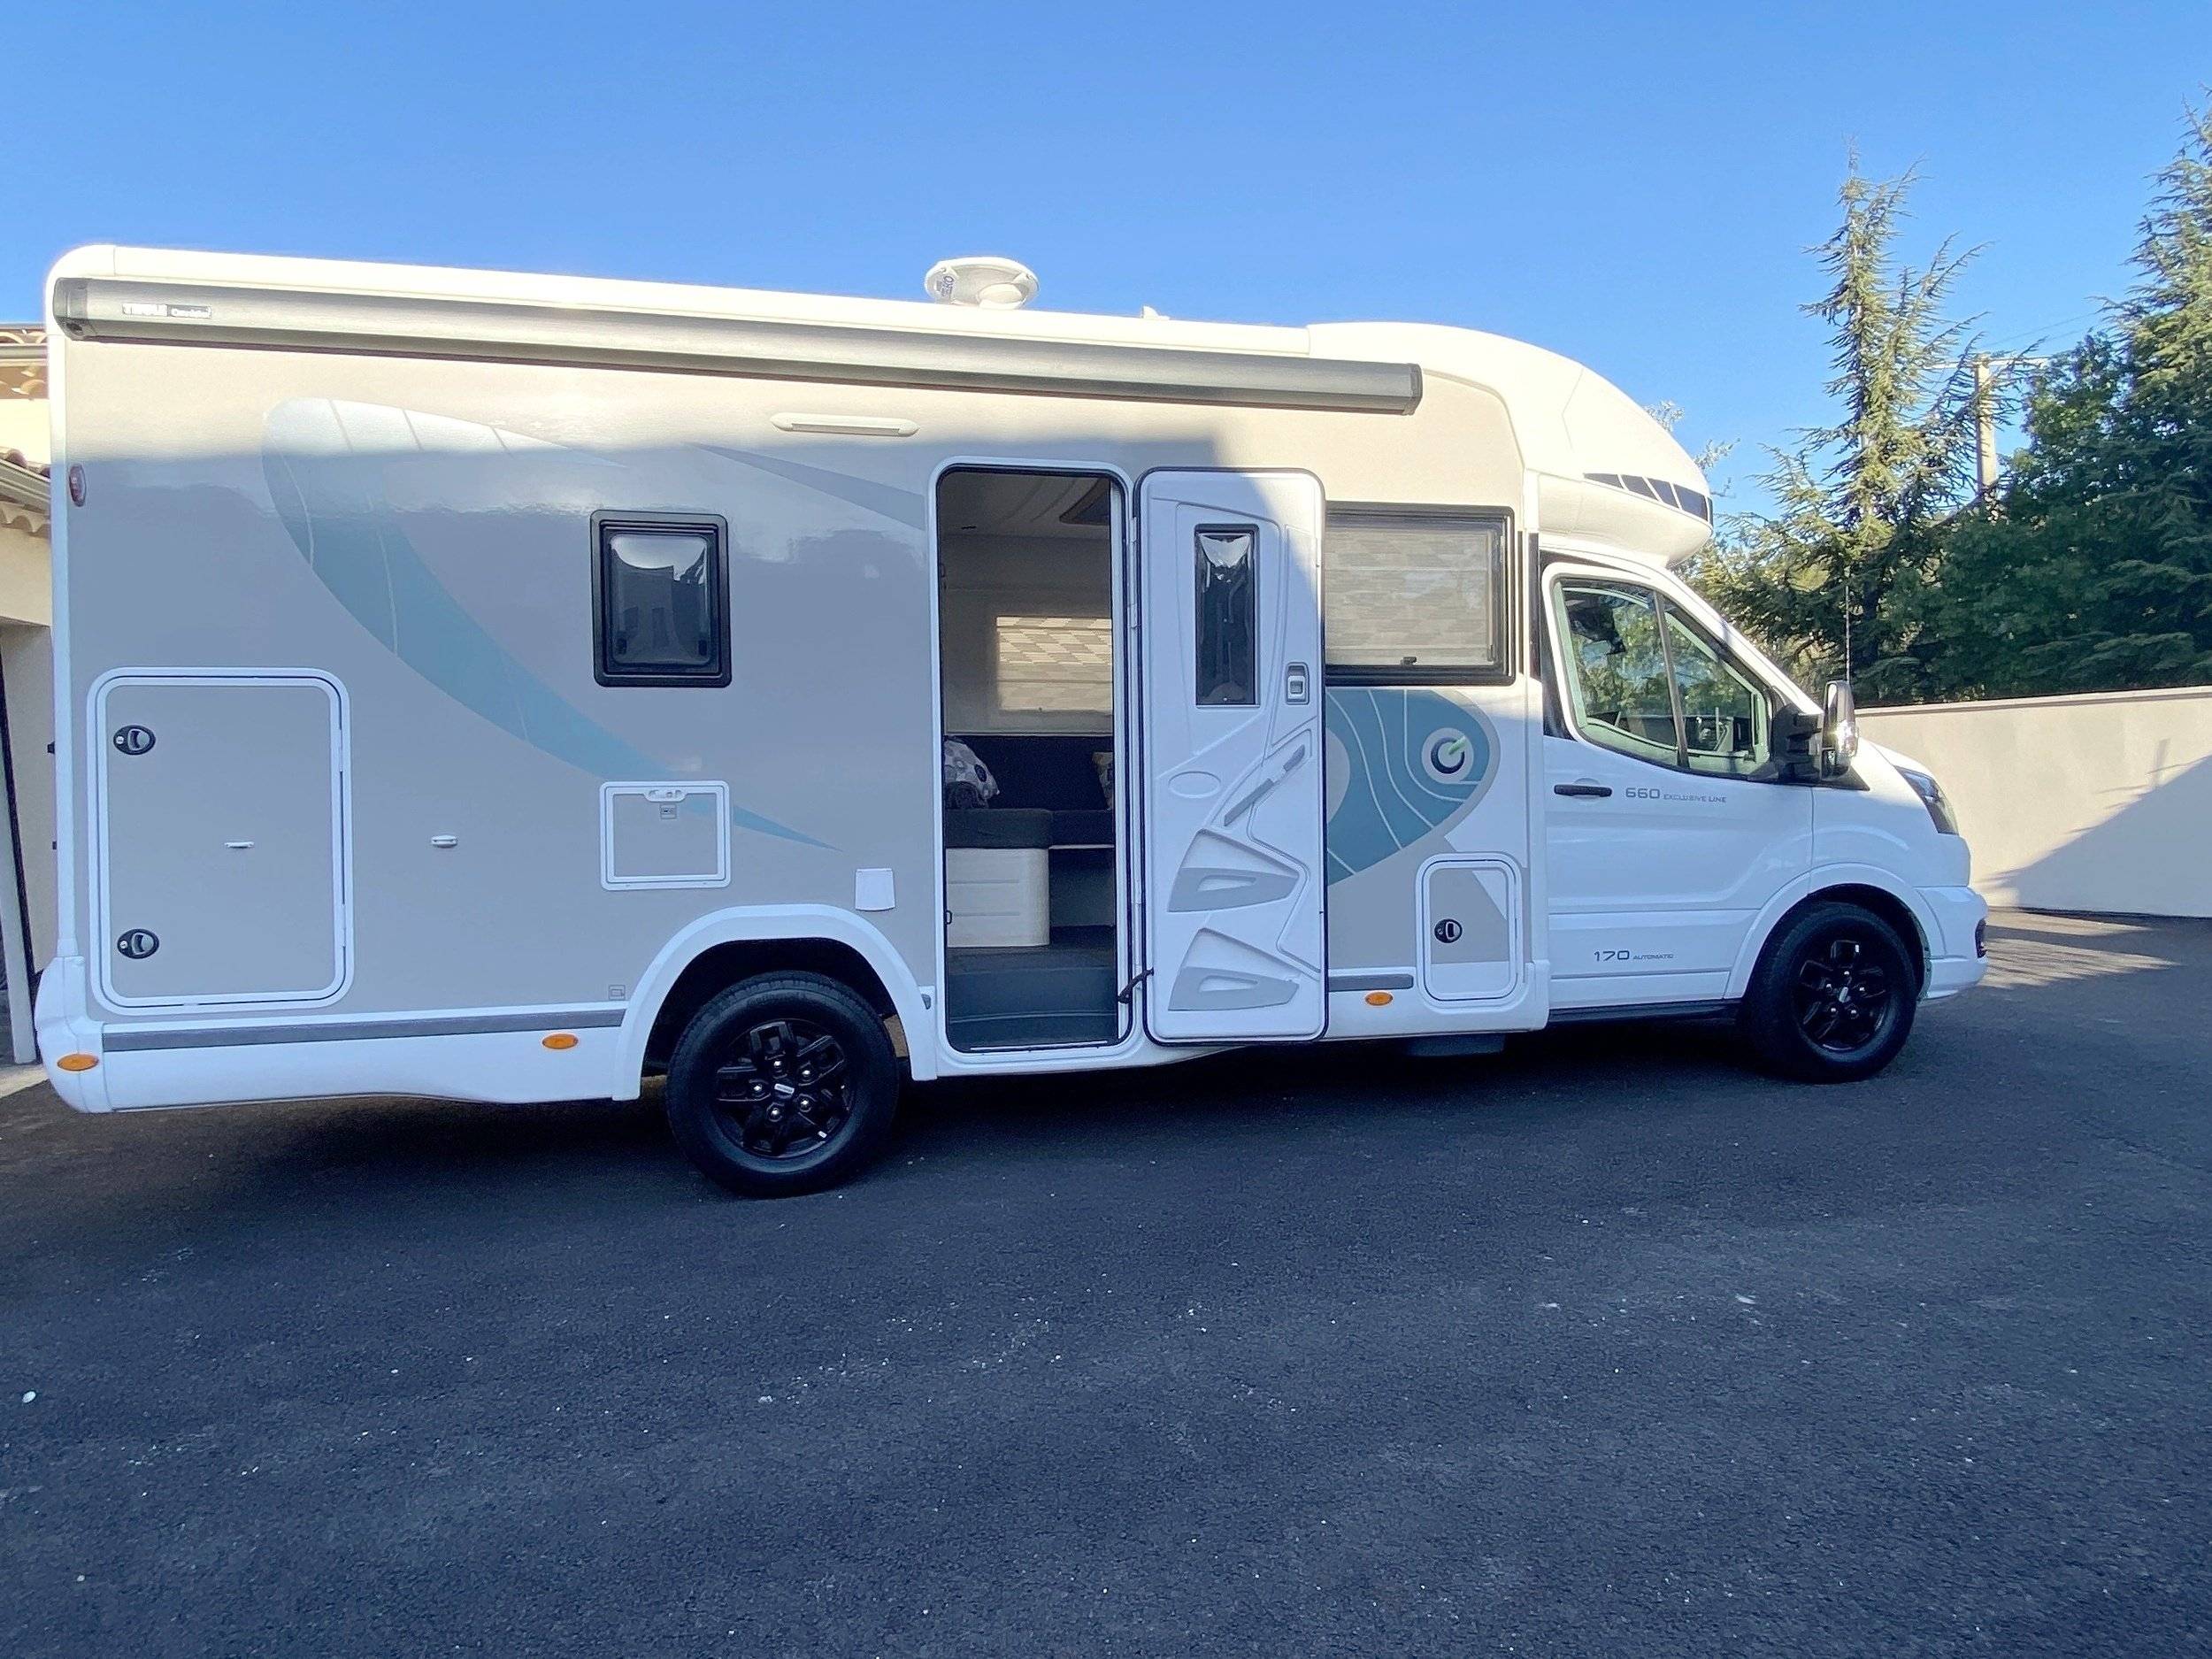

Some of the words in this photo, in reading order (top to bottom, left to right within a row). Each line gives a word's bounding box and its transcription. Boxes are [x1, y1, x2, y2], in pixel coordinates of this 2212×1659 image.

[1625, 787, 1660, 799] 660
[1663, 794, 1706, 803] EXCLUSIVE
[1594, 949, 1630, 962] 170
